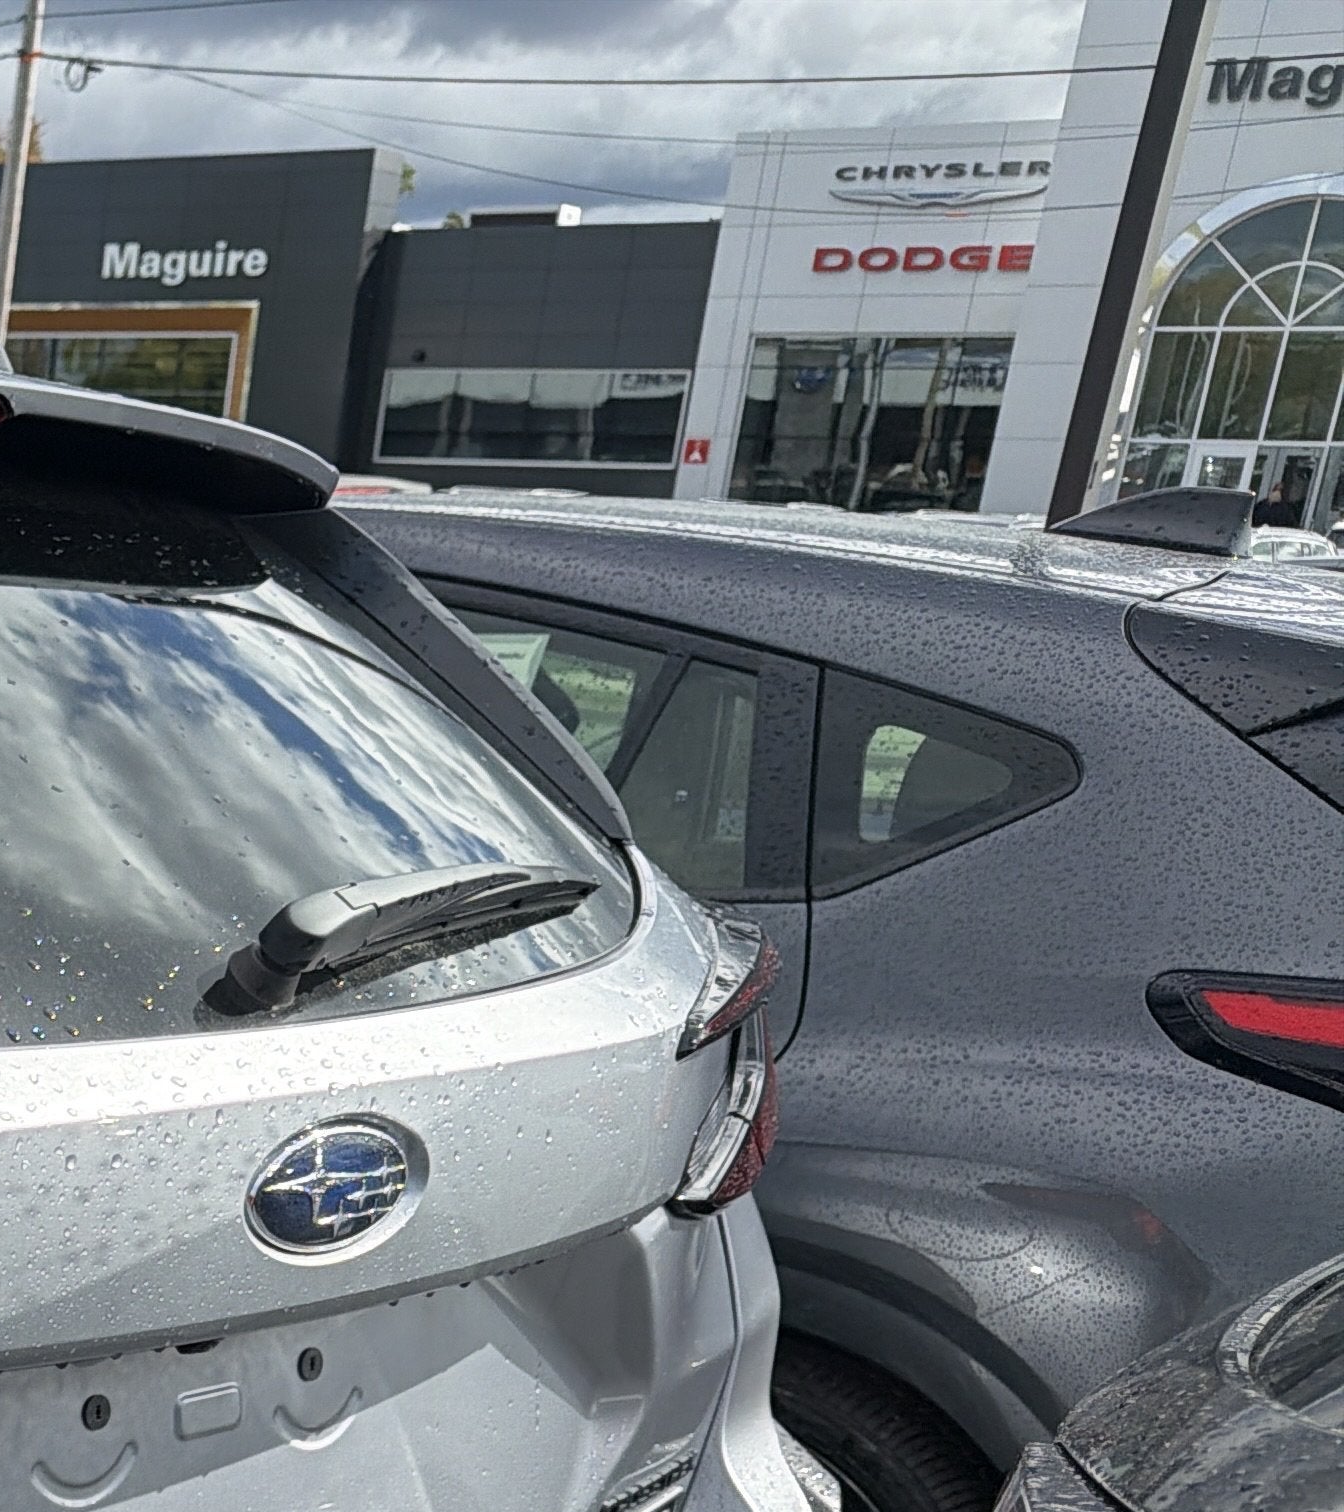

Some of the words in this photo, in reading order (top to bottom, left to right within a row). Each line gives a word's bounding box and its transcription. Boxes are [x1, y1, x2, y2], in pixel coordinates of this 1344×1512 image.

[834, 160, 1052, 182] CHRYSLER
[100, 239, 269, 287] Maguire
[812, 244, 1036, 273] DODGE
